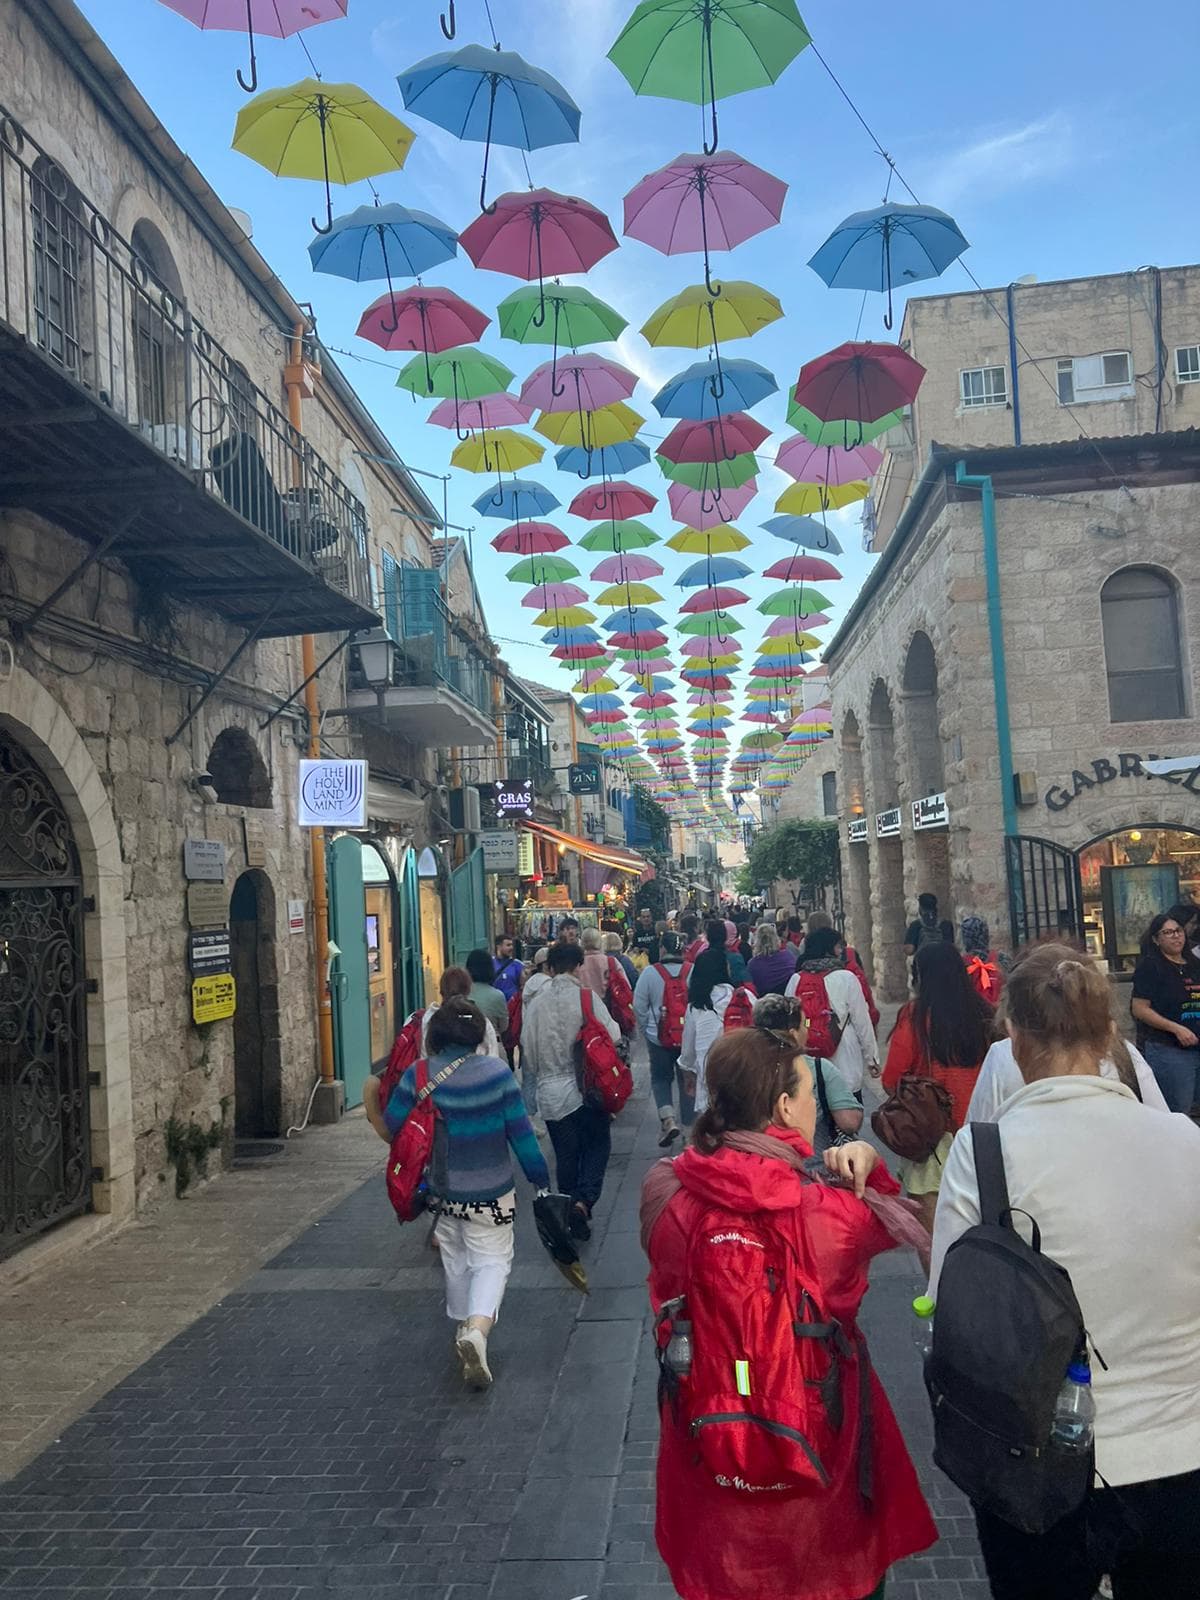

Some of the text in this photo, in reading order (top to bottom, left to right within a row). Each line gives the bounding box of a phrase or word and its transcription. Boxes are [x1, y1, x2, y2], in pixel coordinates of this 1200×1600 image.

[322, 767, 345, 778] THE
[315, 777, 345, 789] HOLY
[313, 789, 345, 800] LAND
[498, 792, 532, 804] GRAS
[314, 800, 344, 810] MINT
